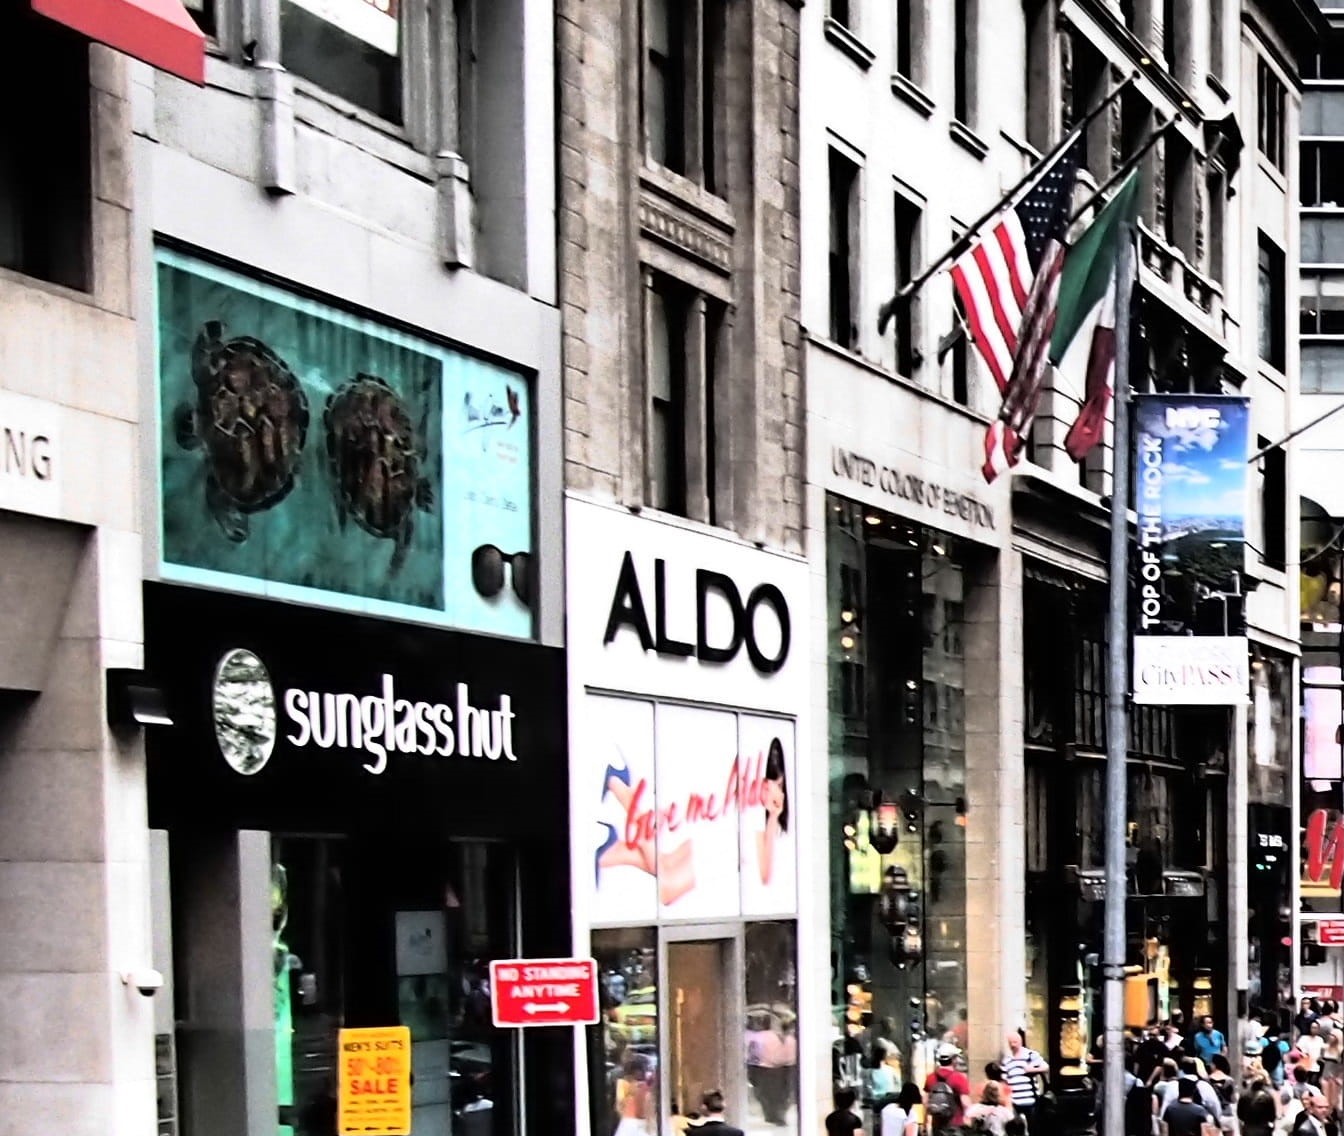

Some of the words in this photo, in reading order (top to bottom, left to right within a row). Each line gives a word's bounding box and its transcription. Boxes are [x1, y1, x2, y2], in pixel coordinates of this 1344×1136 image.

[1143, 435, 1163, 500] ROCK
[1143, 503, 1162, 546] THE
[1142, 552, 1161, 583] OF
[603, 550, 792, 675] ALDO
[1142, 585, 1161, 629] TOP
[285, 674, 455, 775] sunglass
[456, 682, 518, 762] hut
[497, 967, 519, 982] NO
[349, 1078, 399, 1096] SALE
